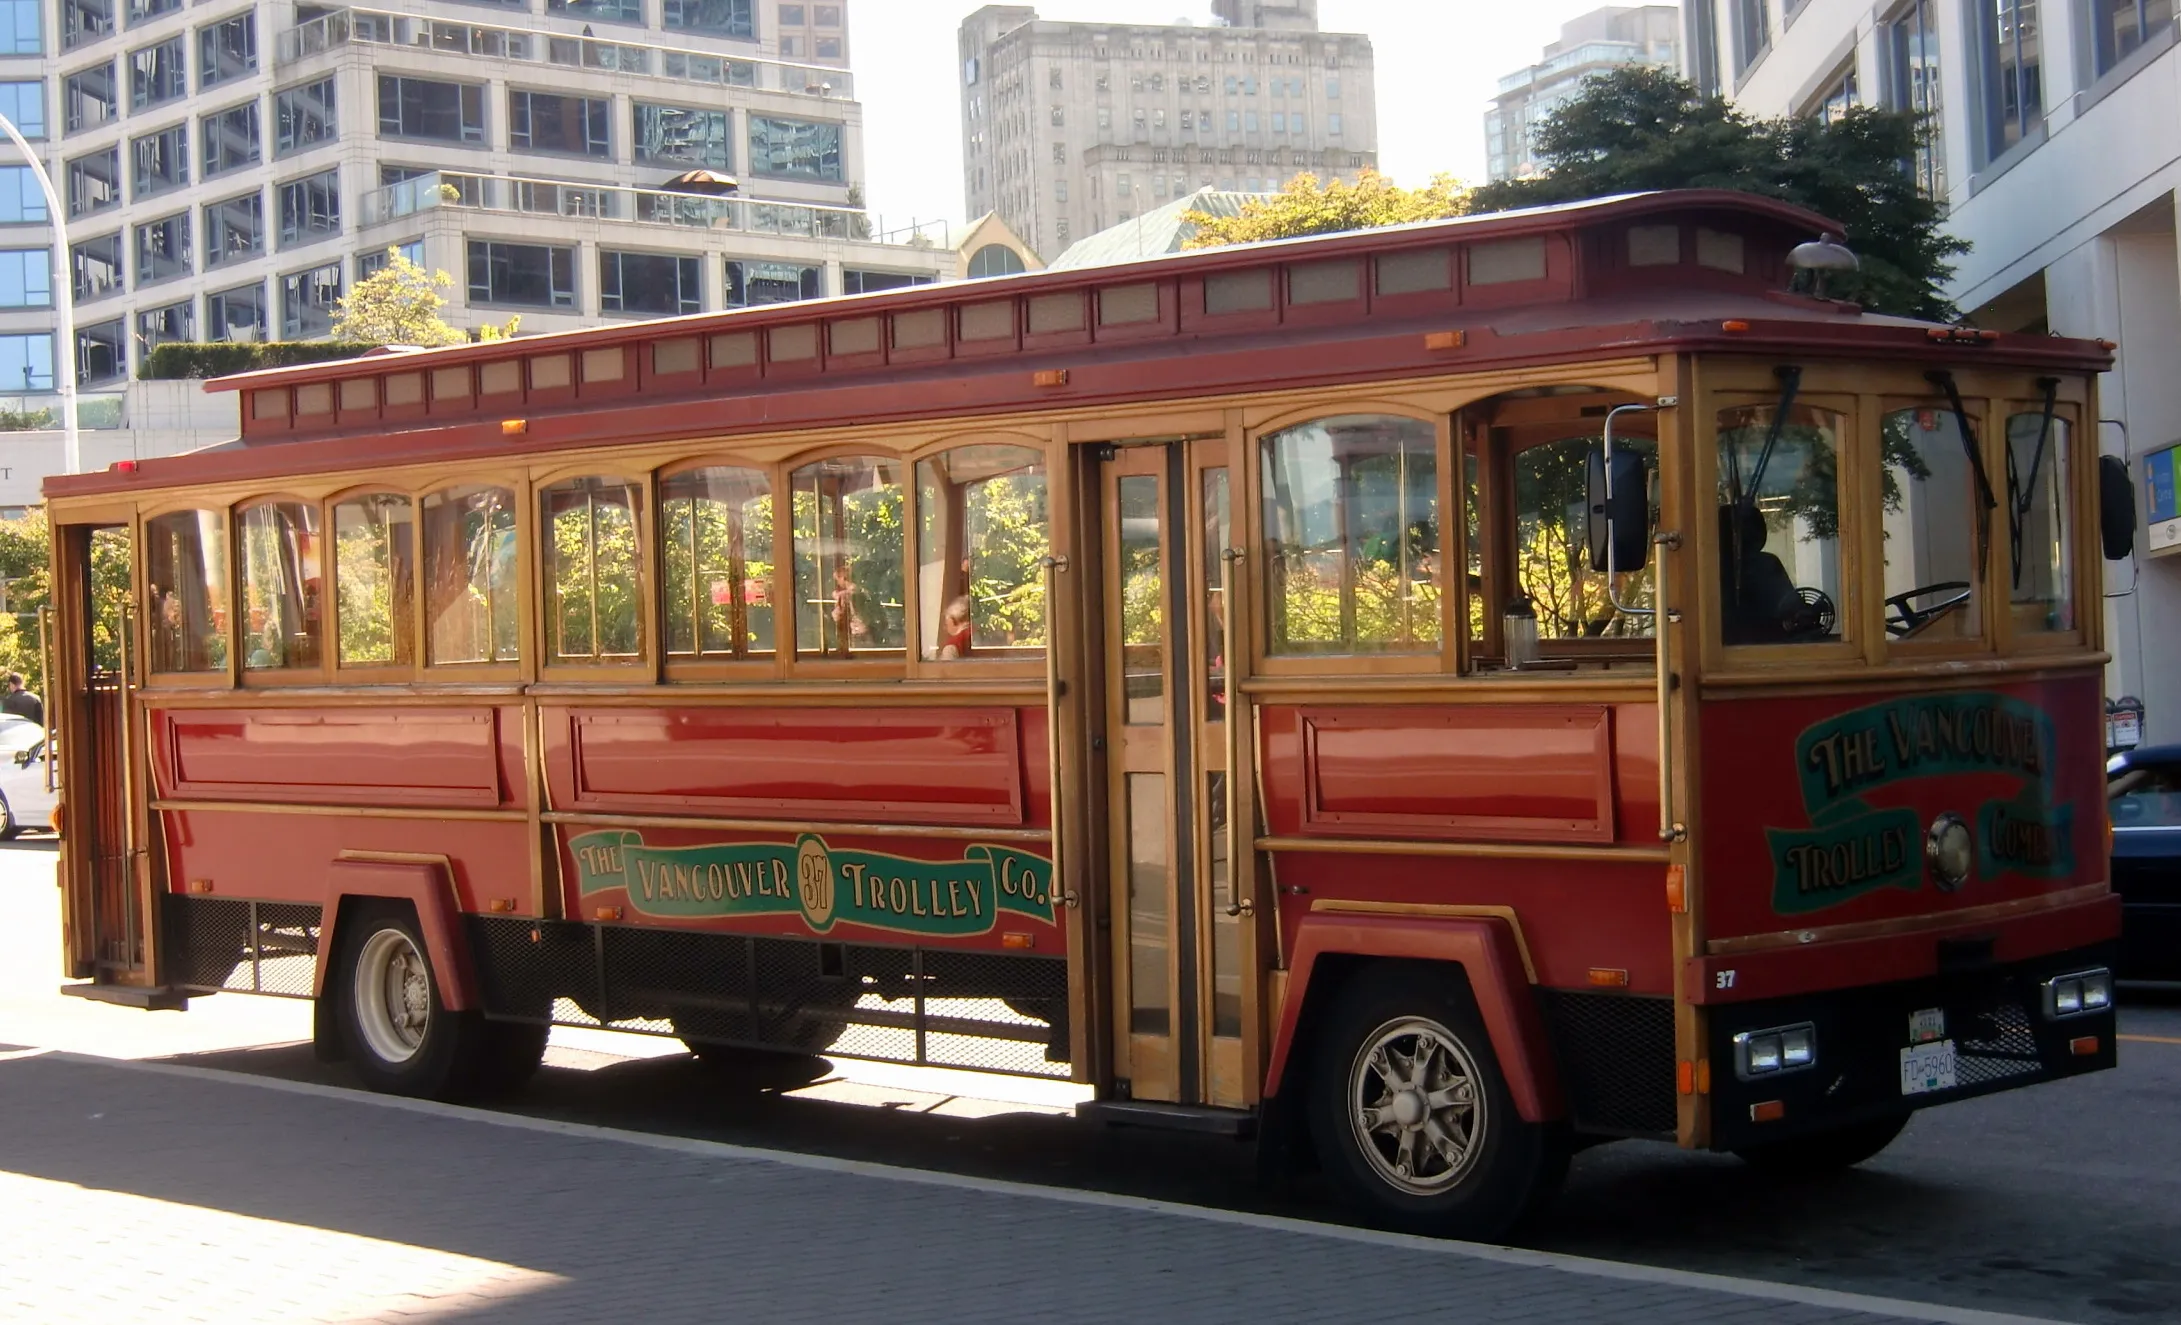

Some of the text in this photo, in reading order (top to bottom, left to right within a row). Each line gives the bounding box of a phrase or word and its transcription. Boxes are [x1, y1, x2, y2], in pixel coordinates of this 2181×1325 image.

[1810, 727, 1886, 792] THE
[580, 845, 1045, 917] THE VANCOUVER TROLLEY CO.
[801, 854, 829, 910] 37
[1786, 823, 1909, 892] TROLLEY
[1716, 969, 1736, 989] 37
